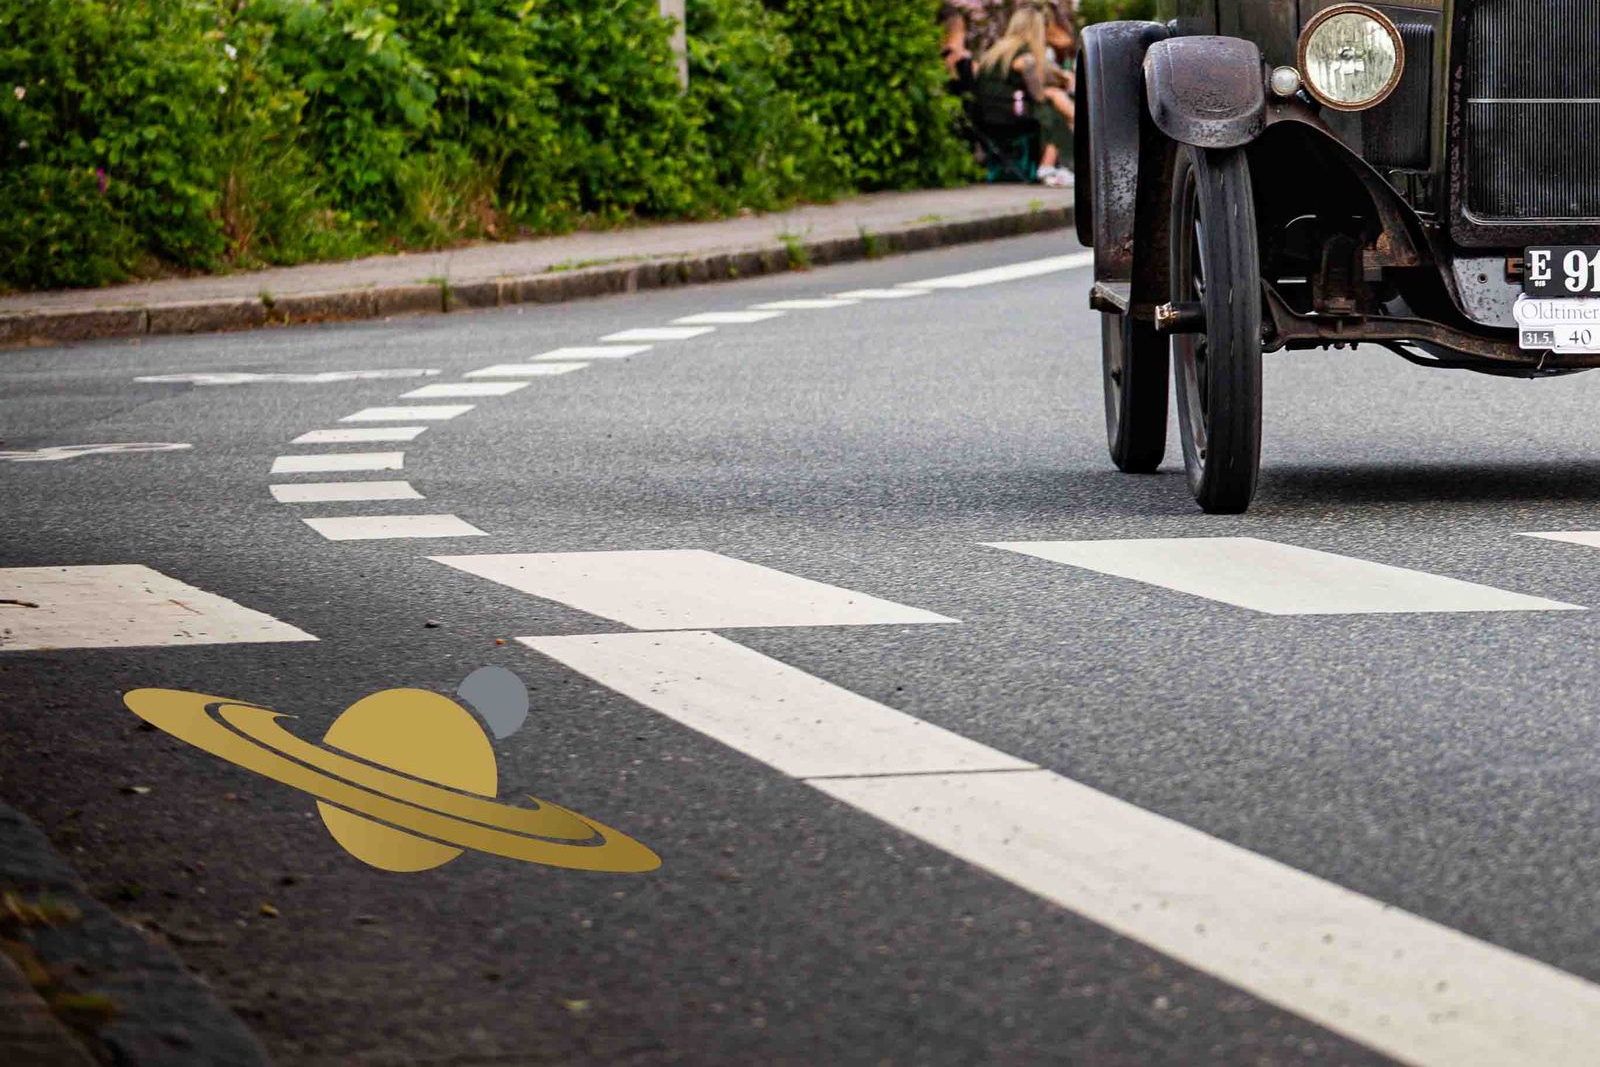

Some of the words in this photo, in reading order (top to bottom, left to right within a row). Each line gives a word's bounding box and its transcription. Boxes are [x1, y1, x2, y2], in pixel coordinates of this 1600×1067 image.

[1529, 250, 1551, 280] E
[1525, 333, 1552, 344] 31.5.
[1569, 329, 1592, 345] 40
